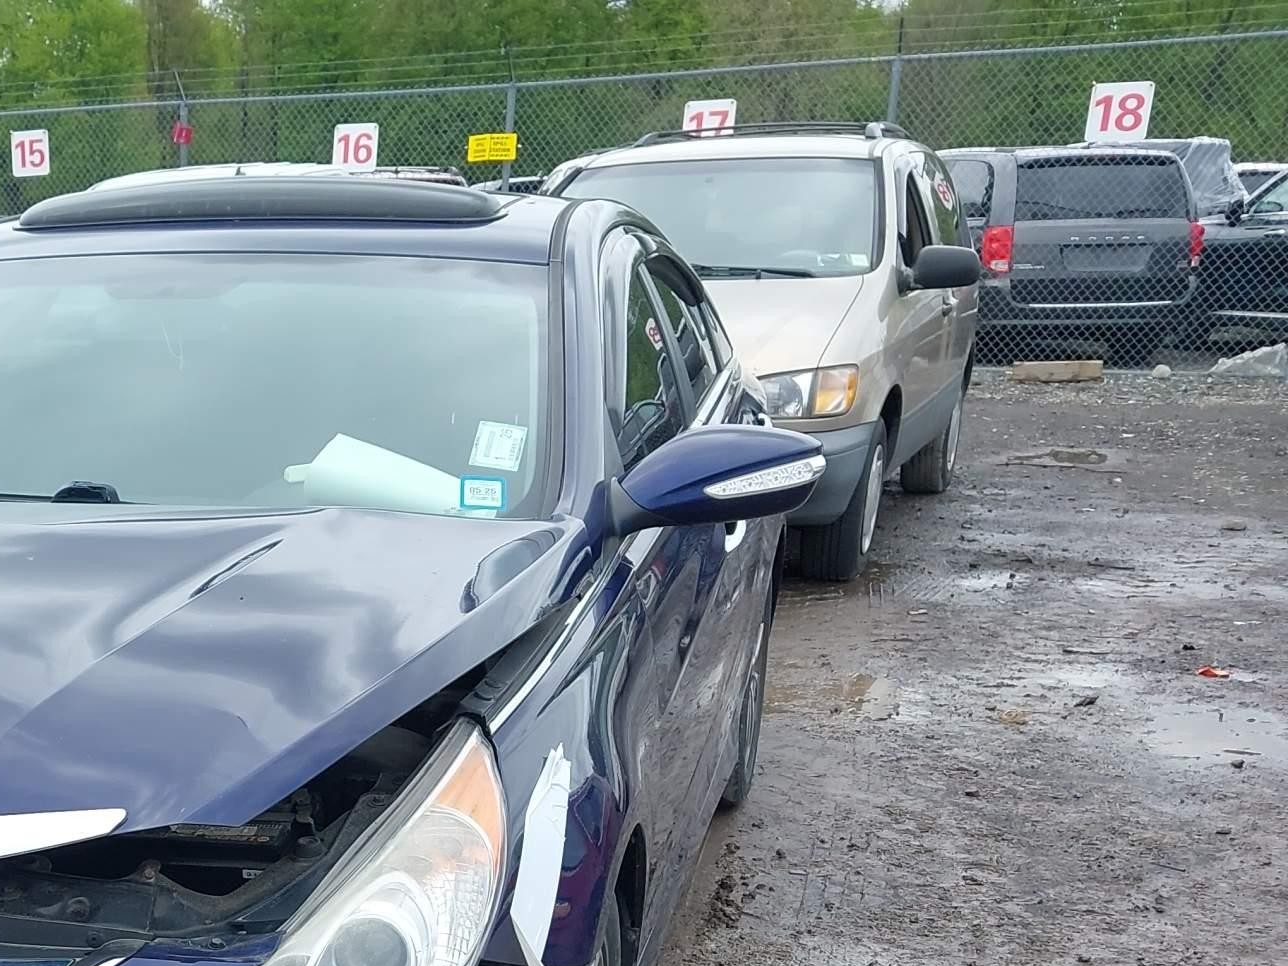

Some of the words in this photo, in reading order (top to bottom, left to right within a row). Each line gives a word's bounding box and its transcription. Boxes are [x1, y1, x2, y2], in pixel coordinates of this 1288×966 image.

[689, 110, 729, 137] 17
[1094, 93, 1146, 132] 18
[14, 138, 45, 169] 15
[337, 132, 374, 164] 16
